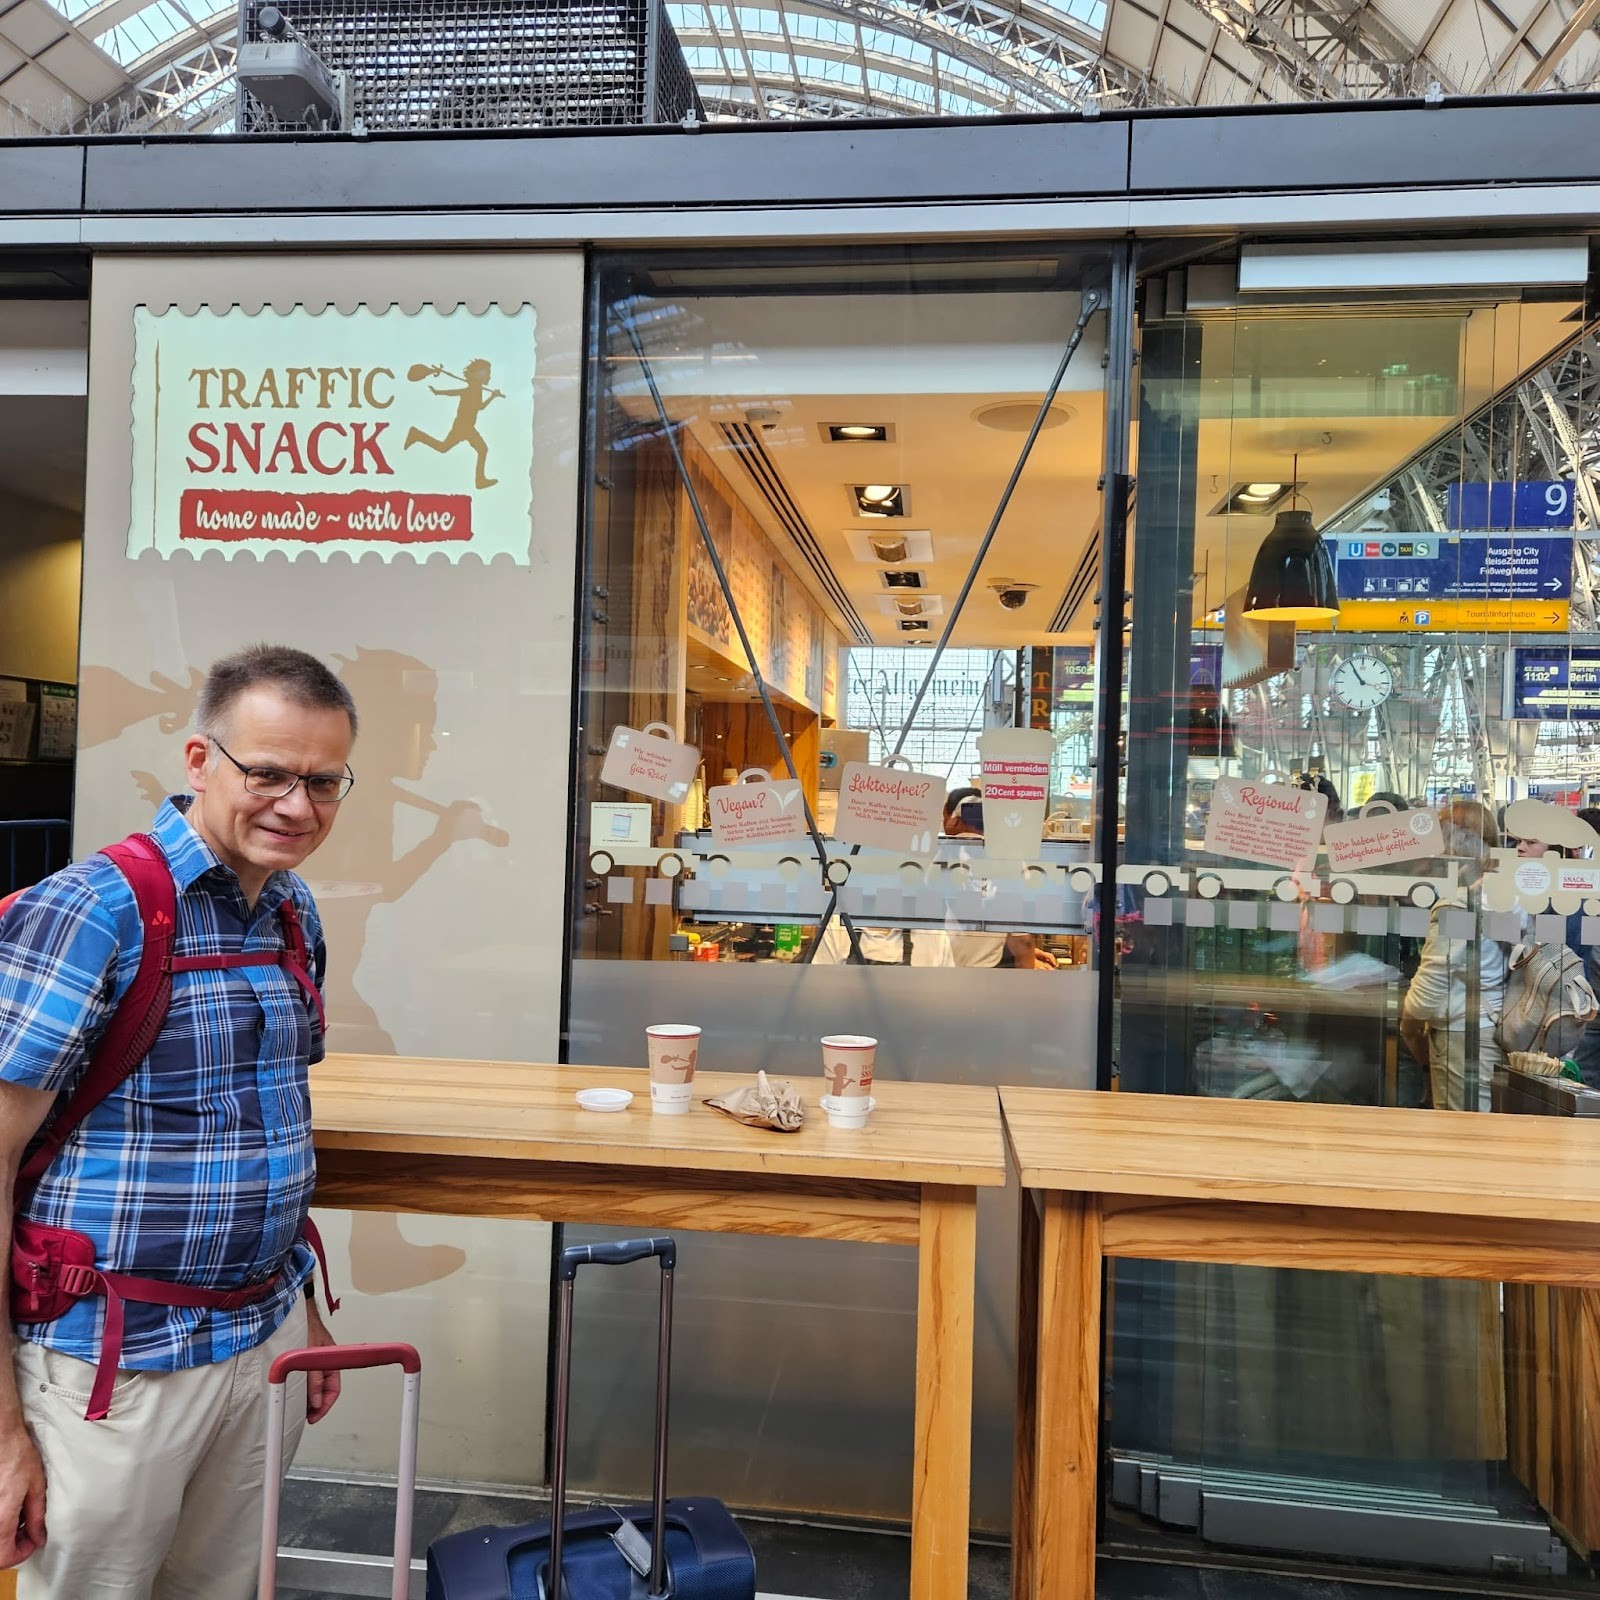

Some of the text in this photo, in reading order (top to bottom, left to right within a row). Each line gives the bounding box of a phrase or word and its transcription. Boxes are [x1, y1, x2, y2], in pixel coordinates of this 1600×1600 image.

[188, 367, 395, 410] TRAFFIC
[185, 421, 395, 475] SNACK
[1545, 484, 1567, 516] 9
[196, 500, 257, 531] home
[261, 501, 321, 531] made
[348, 500, 402, 531] with
[407, 498, 455, 532] love
[1351, 543, 1362, 557] U
[1416, 543, 1428, 557] S
[1488, 547, 1540, 557] Ausgang City
[1513, 567, 1538, 575] Messe
[1064, 666, 1087, 675] 10:50
[1524, 672, 1550, 681] 11:02
[1570, 673, 1597, 682] Berlin
[984, 763, 1048, 773] Müll vermeiden
[1012, 776, 1018, 784] &
[848, 773, 931, 801] Laktosefrei?
[1017, 790, 1044, 798] sparen.
[717, 792, 766, 819] Vegan?
[869, 801, 887, 809] Kaffee
[1240, 787, 1301, 815] Regional
[1238, 811, 1251, 820] Brot
[739, 820, 758, 828] Kaffee
[1230, 838, 1249, 847] Kaffee
[1332, 828, 1407, 851] Wir haben für Sie
[1335, 838, 1420, 862] durchgehend geöffnet.
